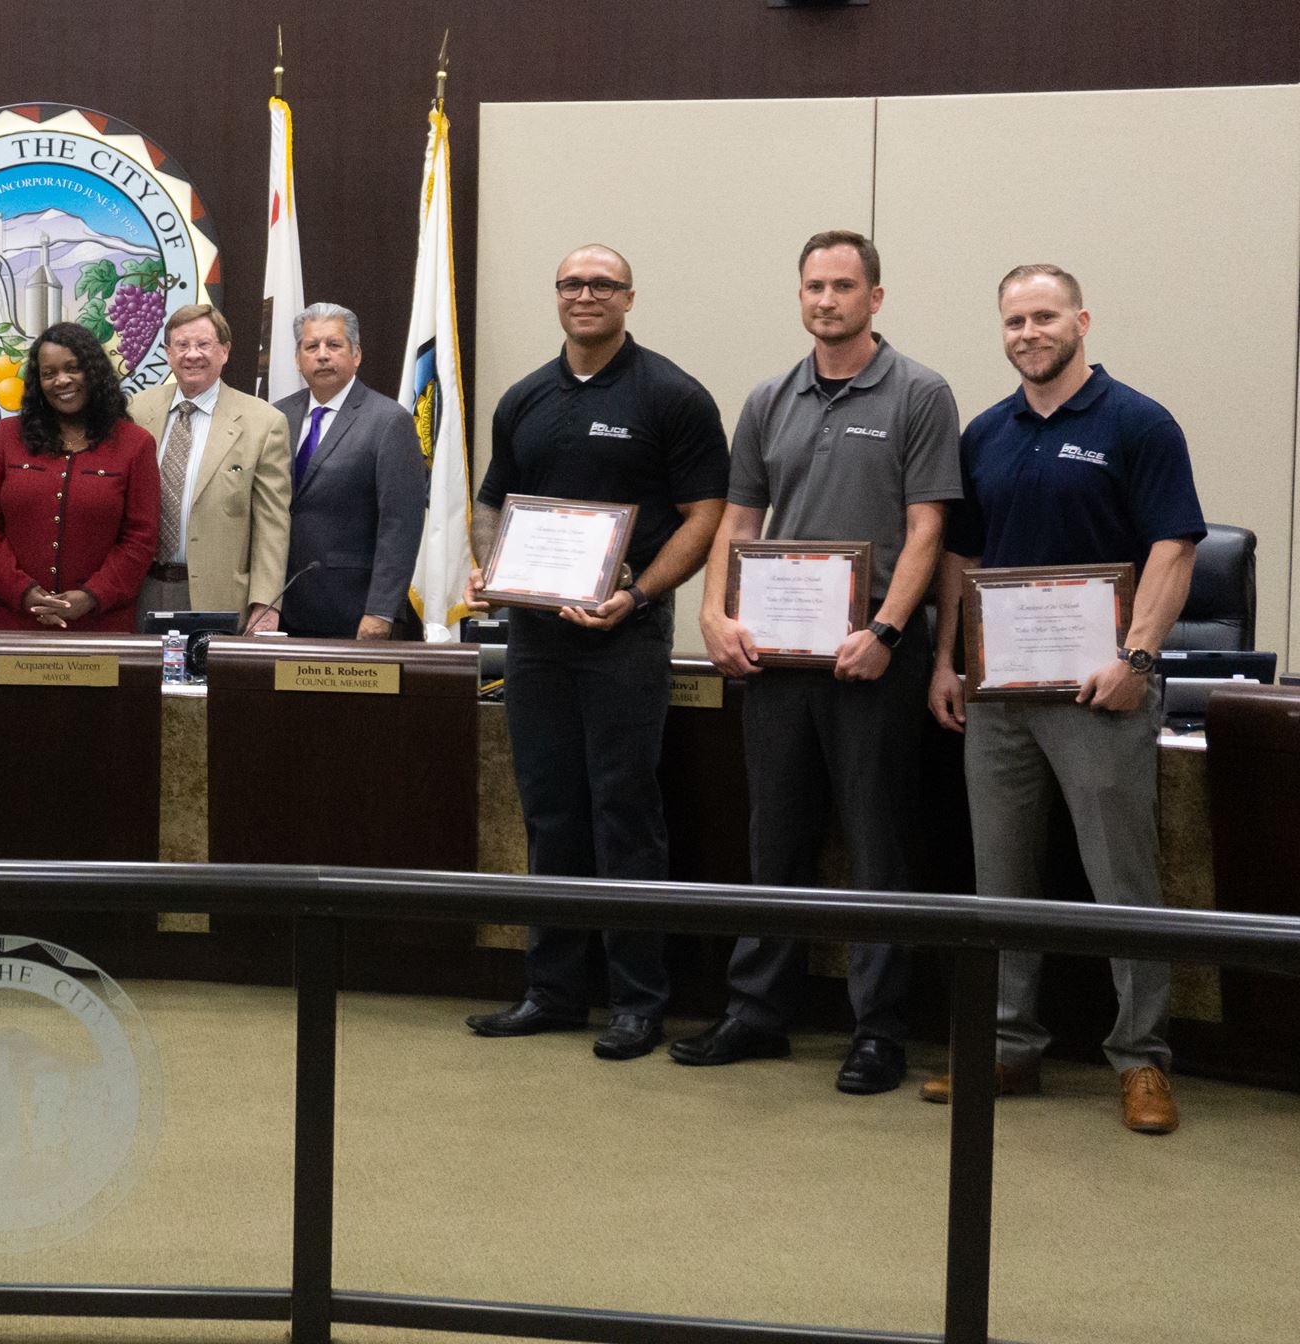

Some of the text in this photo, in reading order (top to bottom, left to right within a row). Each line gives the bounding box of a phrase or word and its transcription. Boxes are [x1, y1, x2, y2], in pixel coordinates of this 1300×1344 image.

[11, 137, 76, 160] THE
[90, 150, 159, 202] CITY
[155, 211, 186, 252] OF
[83, 187, 109, 208] JUNE
[591, 422, 628, 434] POLICE
[845, 427, 887, 438] POLICE
[1061, 445, 1105, 460] POLICE
[14, 660, 101, 672] Acquanetta Warren
[297, 665, 378, 677] John B. Roberts
[42, 673, 70, 681] MAYOR
[295, 677, 379, 688] COUNCIL MEMBER
[670, 679, 699, 690] doval
